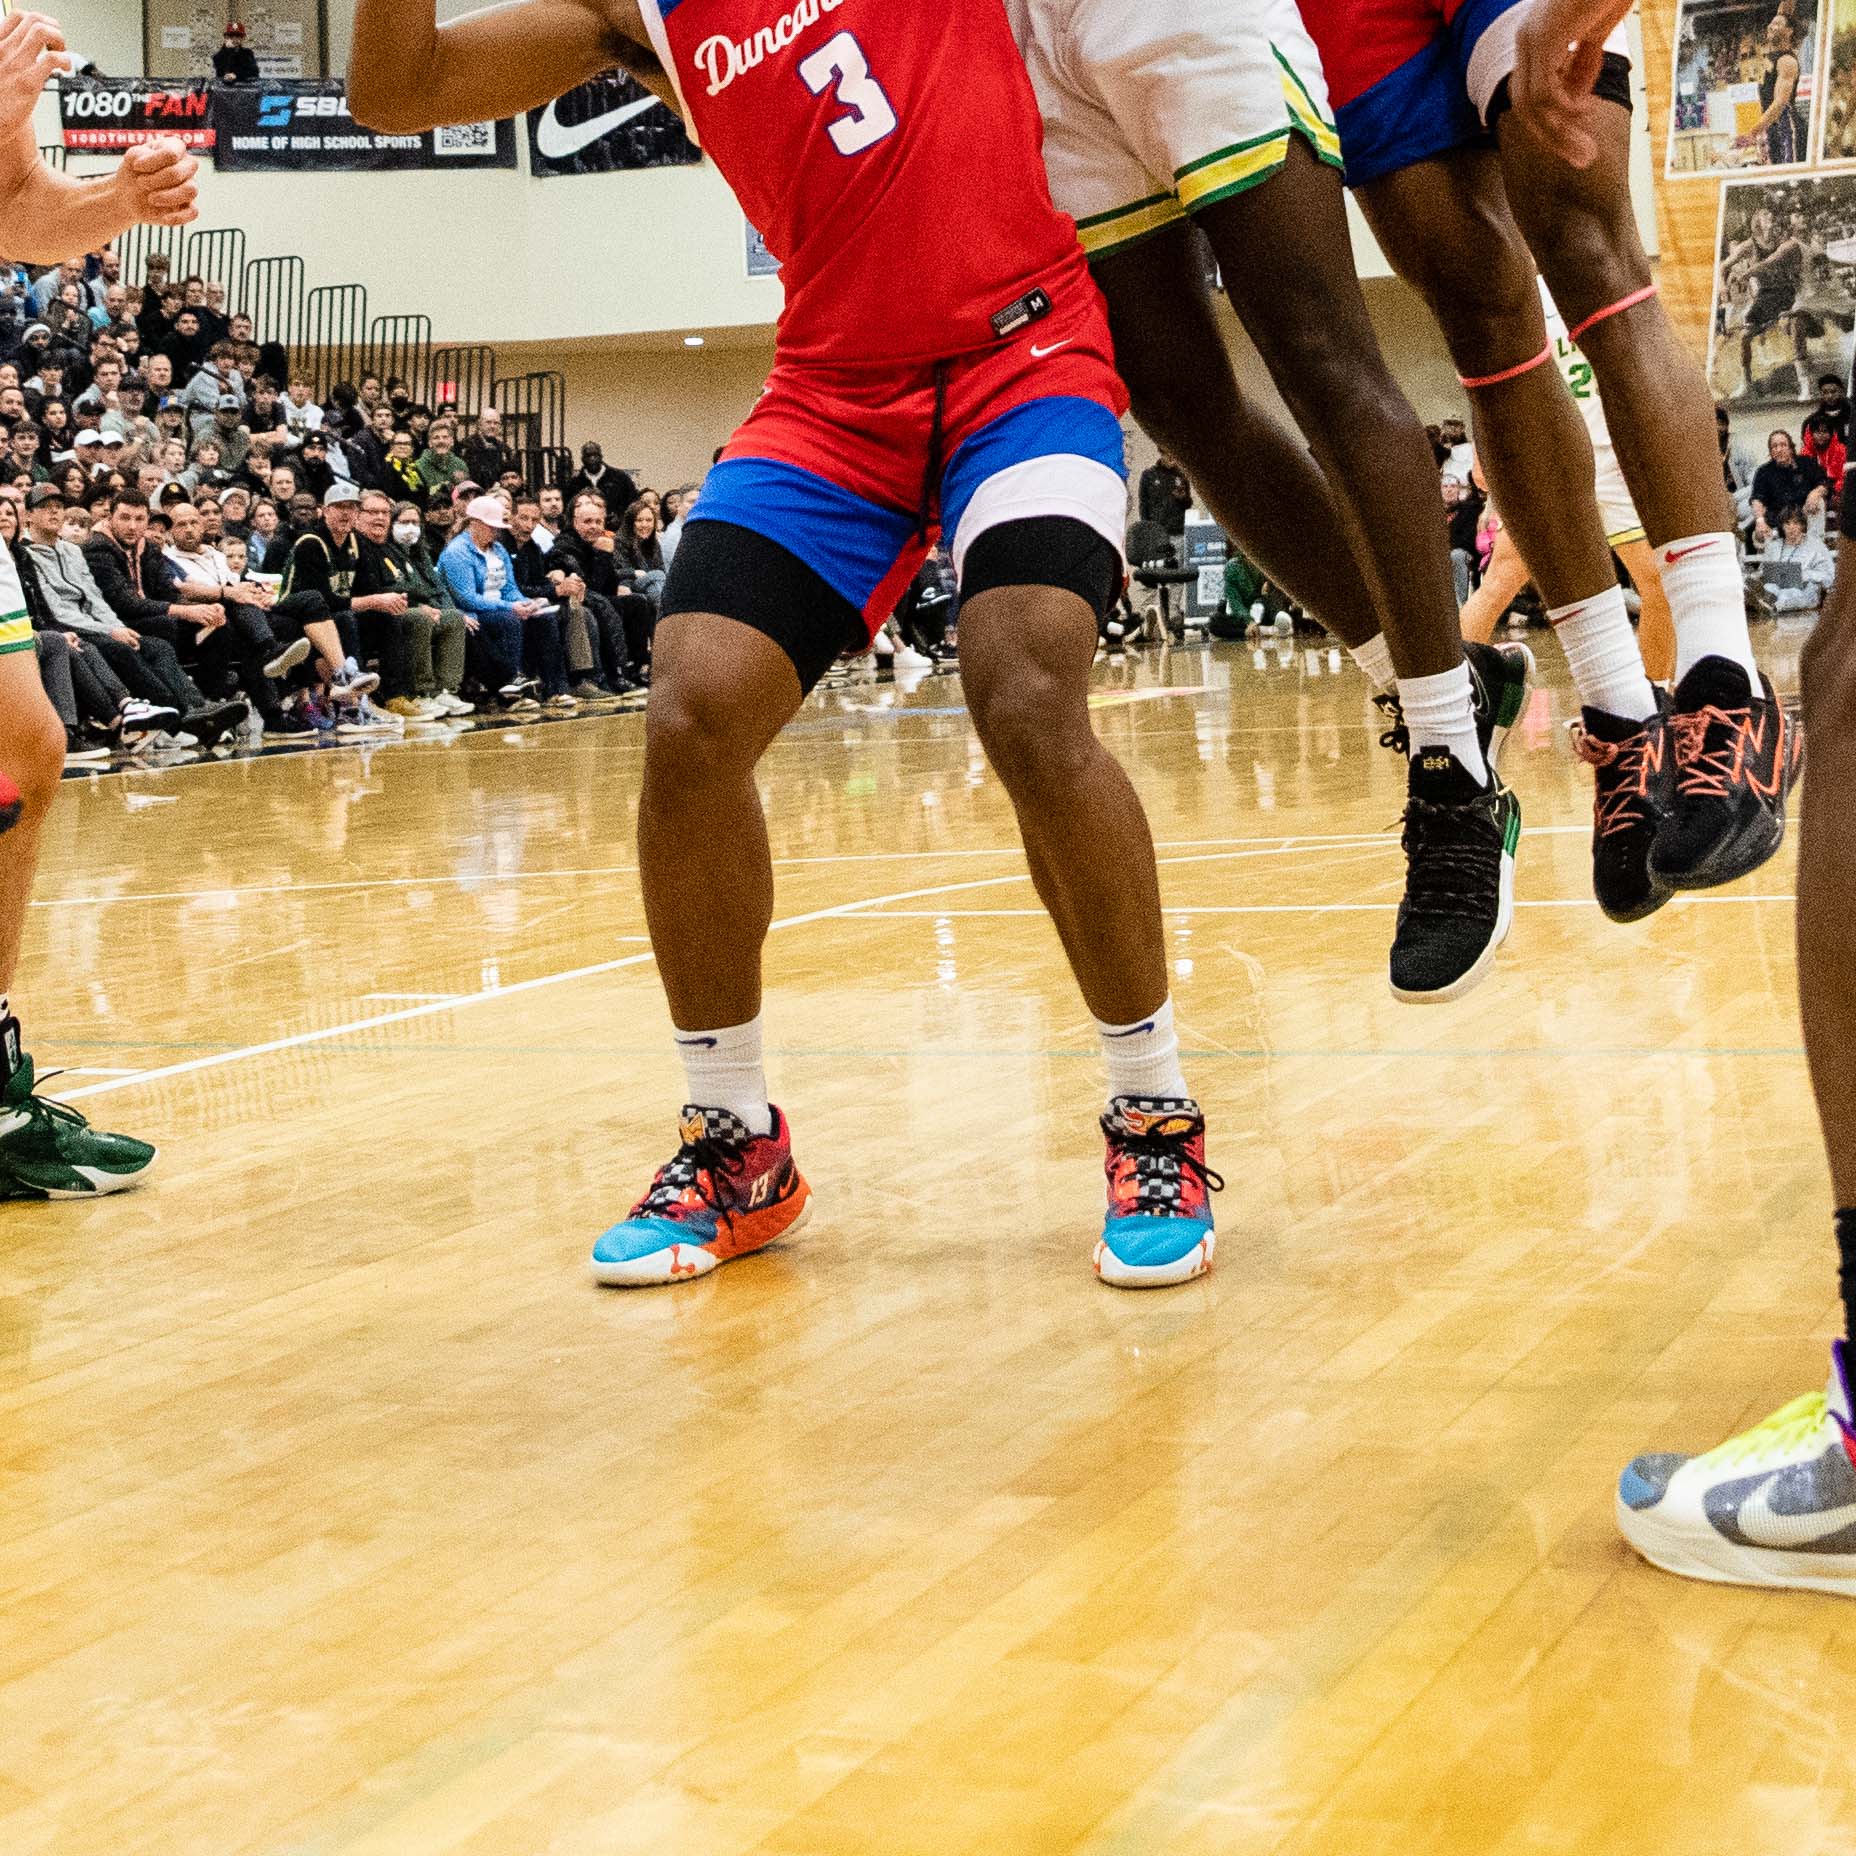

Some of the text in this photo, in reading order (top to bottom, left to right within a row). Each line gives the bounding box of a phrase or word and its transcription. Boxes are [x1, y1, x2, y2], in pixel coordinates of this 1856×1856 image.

[64, 91, 132, 117] 1080
[145, 92, 209, 116] FAN
[796, 29, 900, 158] 3
[71, 131, 206, 145] 1080THEFAOM
[232, 134, 422, 150] HOME OF HIGH SCHOOL SPORTS
